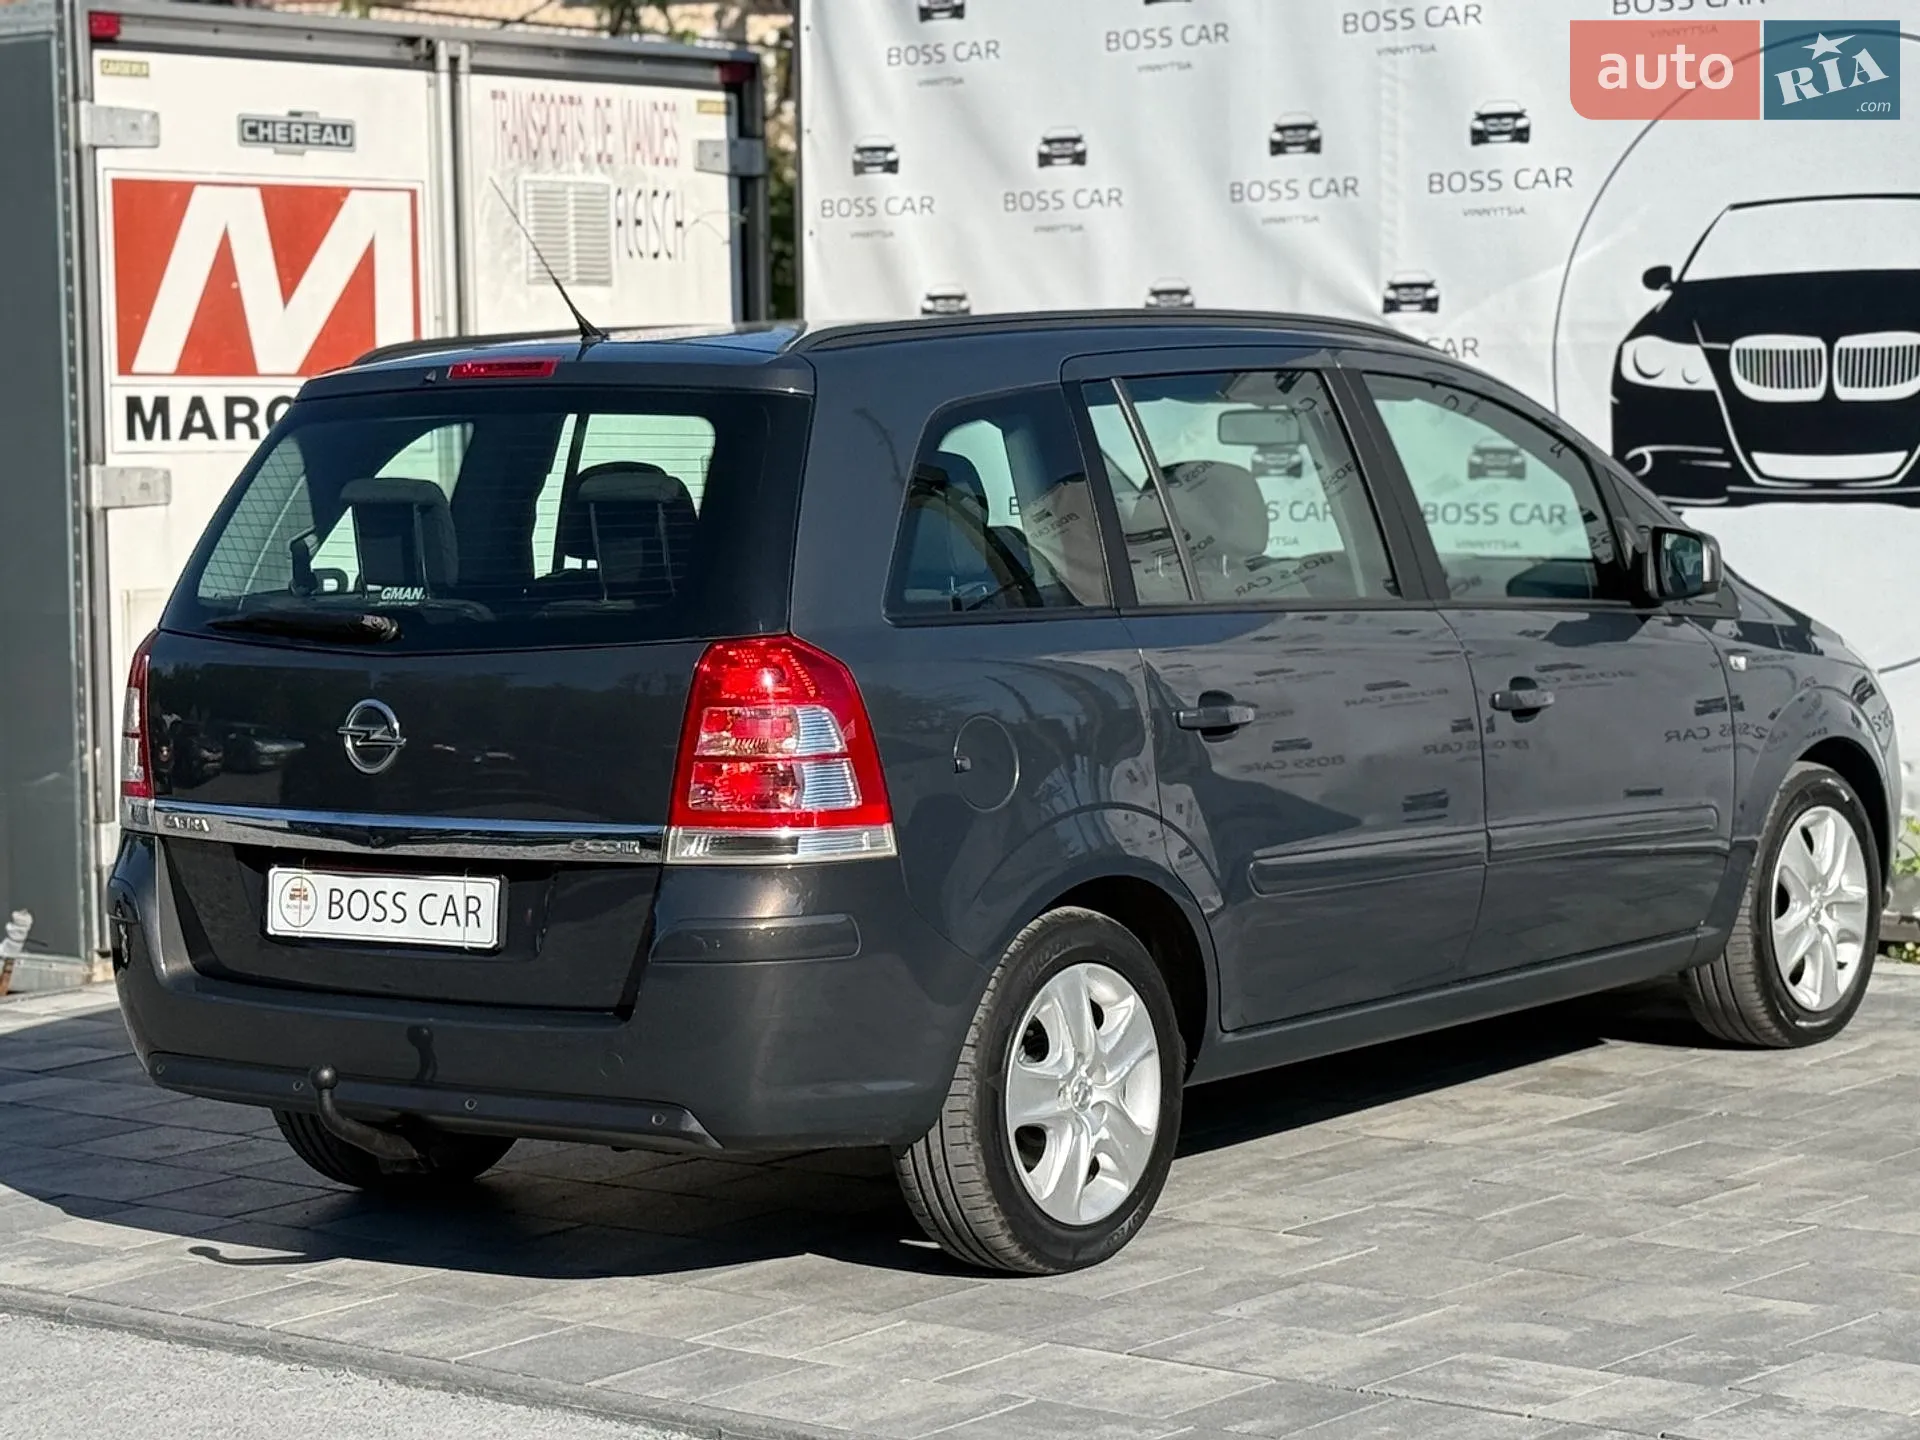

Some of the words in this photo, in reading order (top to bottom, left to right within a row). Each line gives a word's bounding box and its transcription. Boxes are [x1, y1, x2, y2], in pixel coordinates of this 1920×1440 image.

[1343, 7, 1415, 34] BOSS
[1425, 4, 1482, 28] CAR
[1106, 26, 1173, 52] BOSS
[1180, 22, 1229, 46] CAR
[887, 42, 946, 66] BOSS
[953, 39, 1000, 63] CAR
[242, 120, 352, 146] CHEREAU
[489, 88, 587, 166] TRANSPORTS
[592, 96, 616, 165] DE
[619, 98, 681, 169] VIANDES
[1230, 178, 1300, 203] BOSS
[1308, 175, 1360, 199] CAR
[1428, 169, 1503, 194] BOSS
[1514, 166, 1573, 190] CAR
[821, 196, 877, 218] BOSS
[885, 195, 935, 216] CAR
[1003, 189, 1065, 212] BOSS
[1073, 187, 1123, 210] CAR
[614, 186, 686, 262] FLEISCH
[1423, 501, 1499, 526] BOSS
[1509, 502, 1568, 526] CAR
[327, 887, 407, 924] BOSS
[418, 892, 482, 929] CAR
